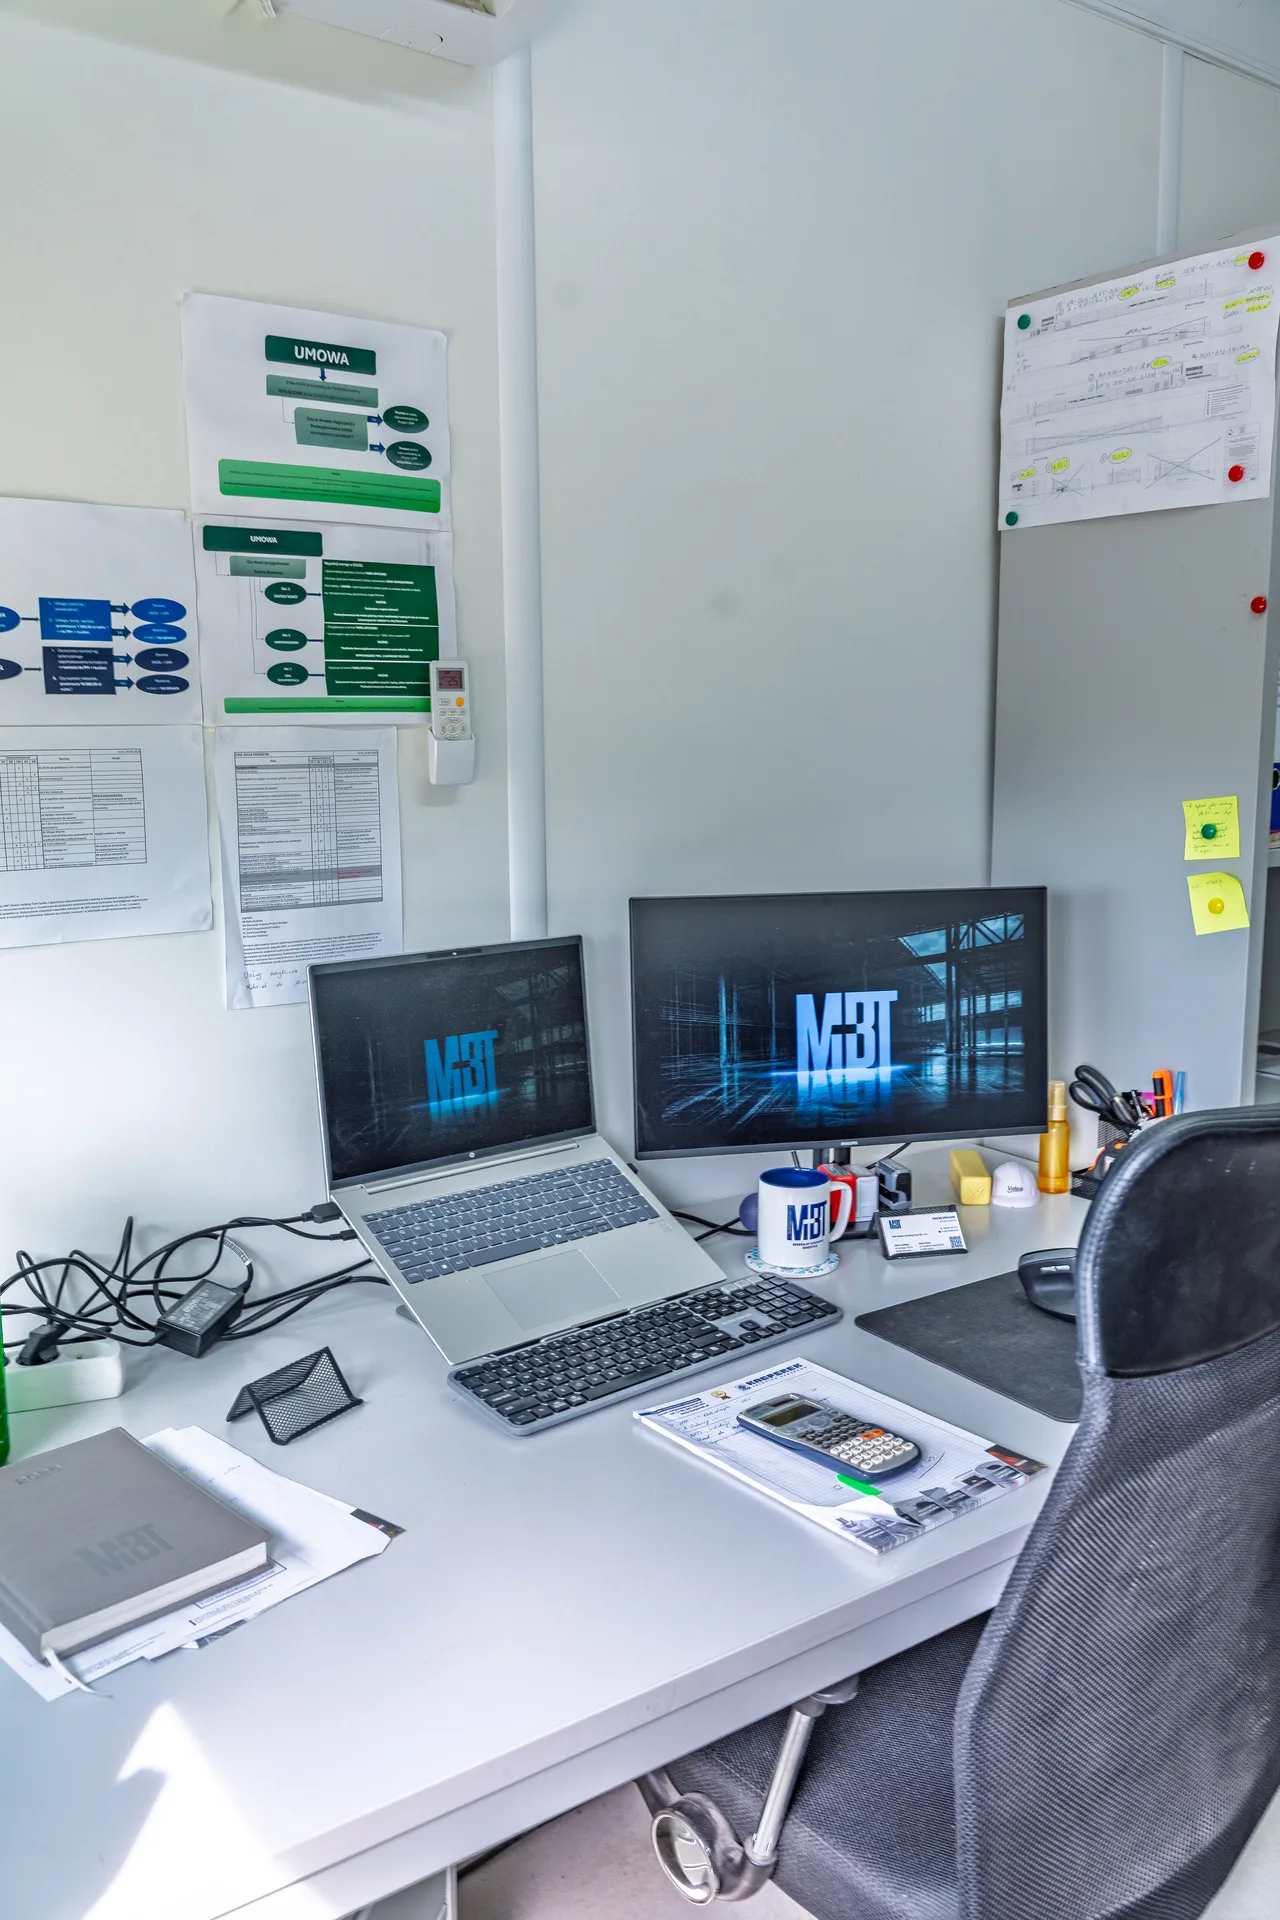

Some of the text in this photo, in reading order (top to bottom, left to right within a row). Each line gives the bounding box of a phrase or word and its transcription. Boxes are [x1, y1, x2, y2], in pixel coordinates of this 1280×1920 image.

[294, 345, 350, 366] UMOWA
[249, 535, 278, 544] UMOWA
[795, 989, 899, 1073] MBT
[424, 1029, 499, 1103] MBT
[787, 1199, 828, 1241] MBT
